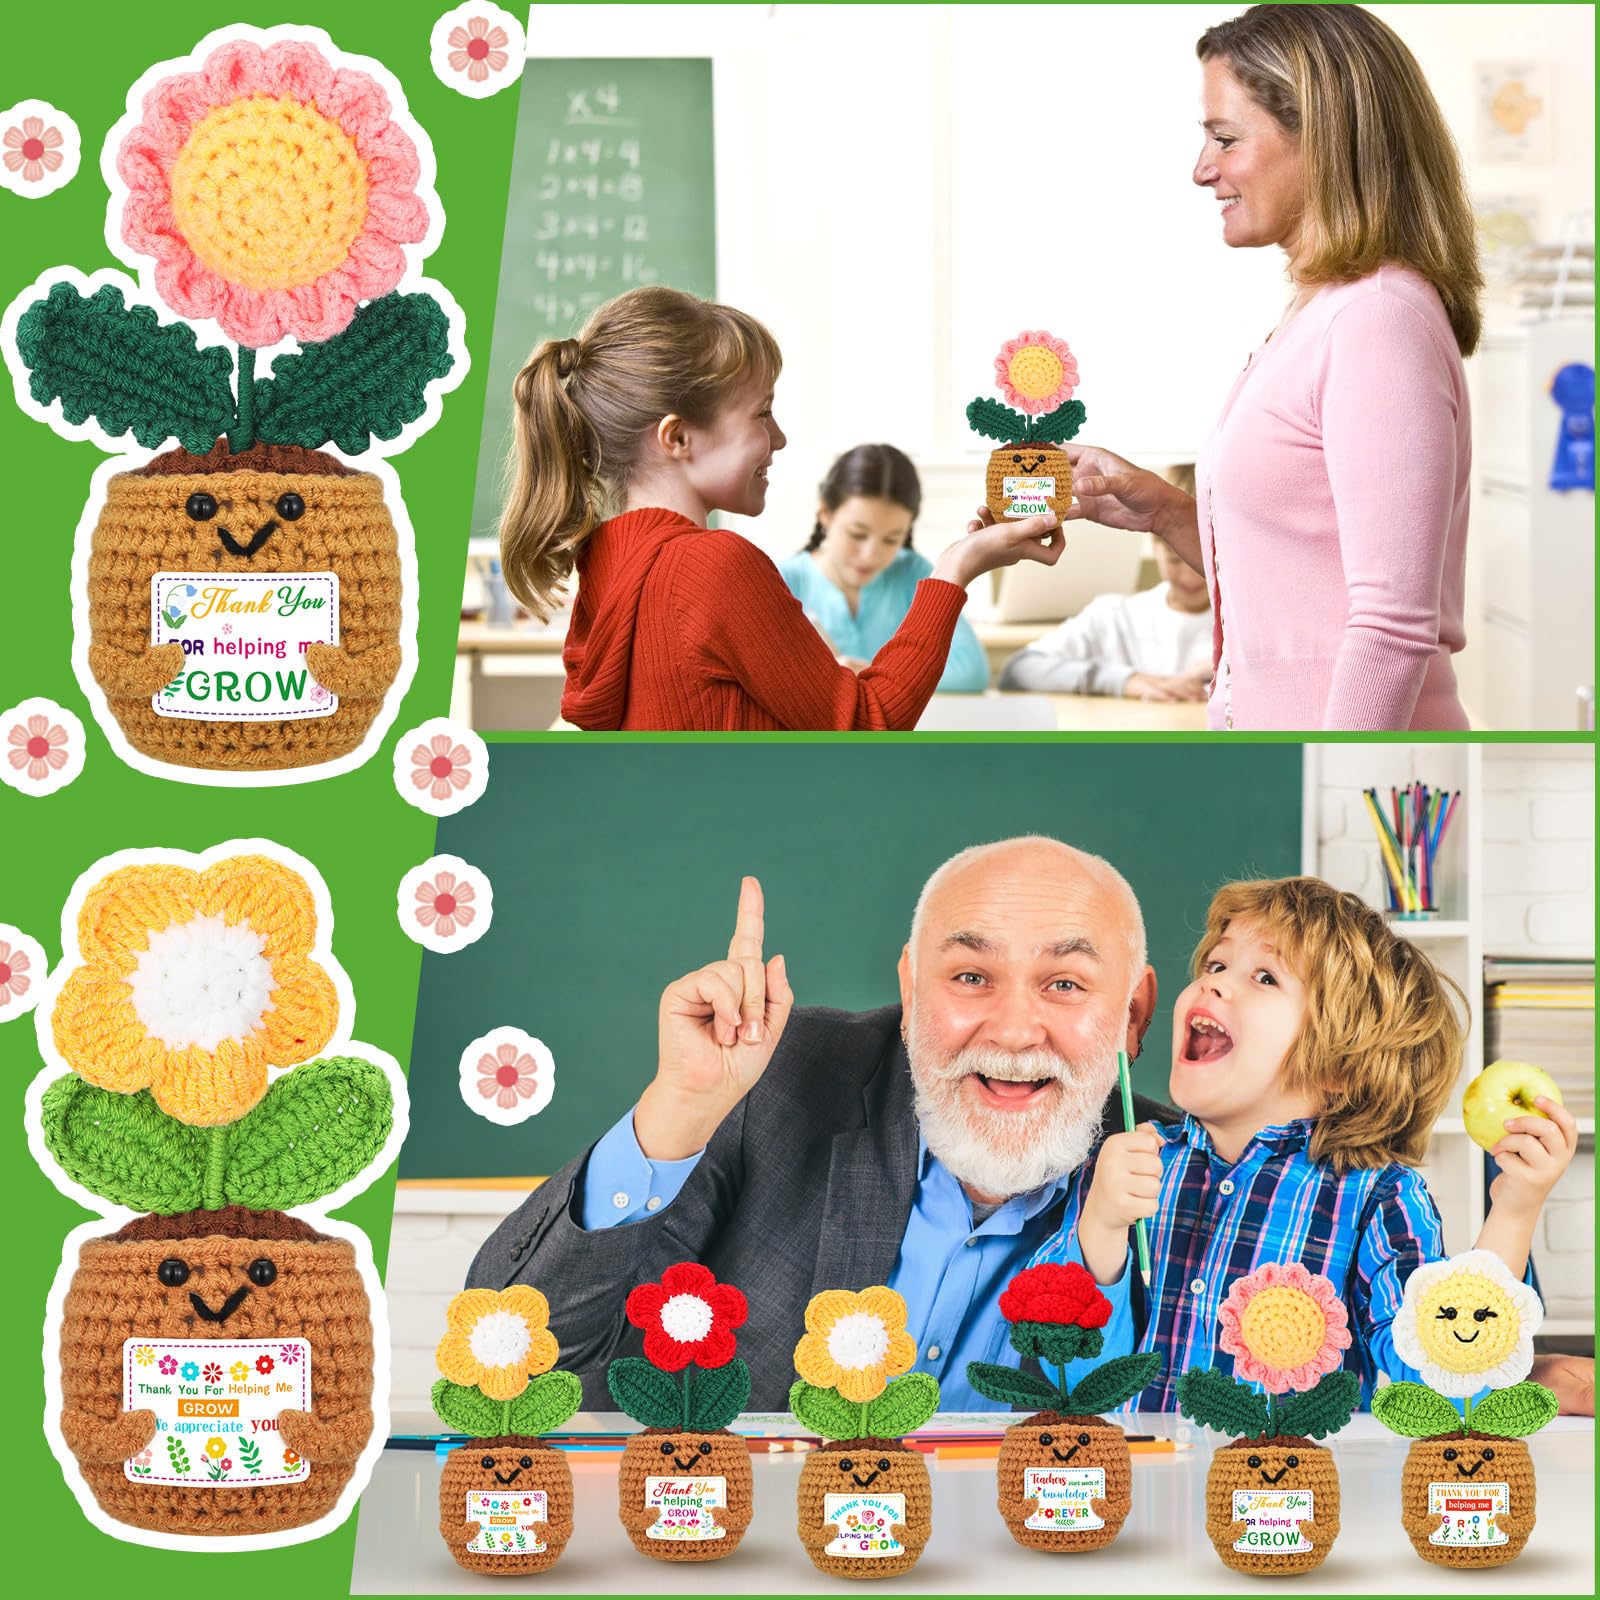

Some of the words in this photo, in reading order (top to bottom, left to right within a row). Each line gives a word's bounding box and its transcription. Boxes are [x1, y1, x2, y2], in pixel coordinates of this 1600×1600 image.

[1013, 504, 1046, 513] GROW
[191, 587, 274, 619] Thank
[277, 585, 326, 617] You
[214, 637, 286, 659] helping
[298, 640, 325, 654] m
[186, 670, 307, 702] GROW
[138, 1384, 172, 1395] Thank
[178, 1385, 198, 1395] You
[205, 1386, 224, 1395] For
[229, 1384, 270, 1395] Helping
[276, 1382, 293, 1393] Me
[183, 1403, 234, 1414] GROW
[175, 1419, 243, 1433] appreciate
[251, 1419, 279, 1434] you
[1030, 1473, 1067, 1486] Teachers
[653, 1482, 693, 1497] Thank
[695, 1482, 715, 1495] You
[1042, 1489, 1089, 1500] knowledge
[1435, 1489, 1462, 1497] THANK
[1463, 1489, 1481, 1497] YOU
[664, 1496, 702, 1508] helping
[1250, 1496, 1285, 1510] Thank
[1287, 1496, 1307, 1509] You
[1448, 1501, 1476, 1509] helping
[668, 1509, 698, 1517] GROW
[831, 1500, 859, 1520] THANK
[862, 1500, 881, 1508] YOU
[883, 1505, 899, 1520] FOR
[1260, 1518, 1291, 1527] helping
[860, 1539, 899, 1550] GROW
[1248, 1532, 1300, 1546] GROW
